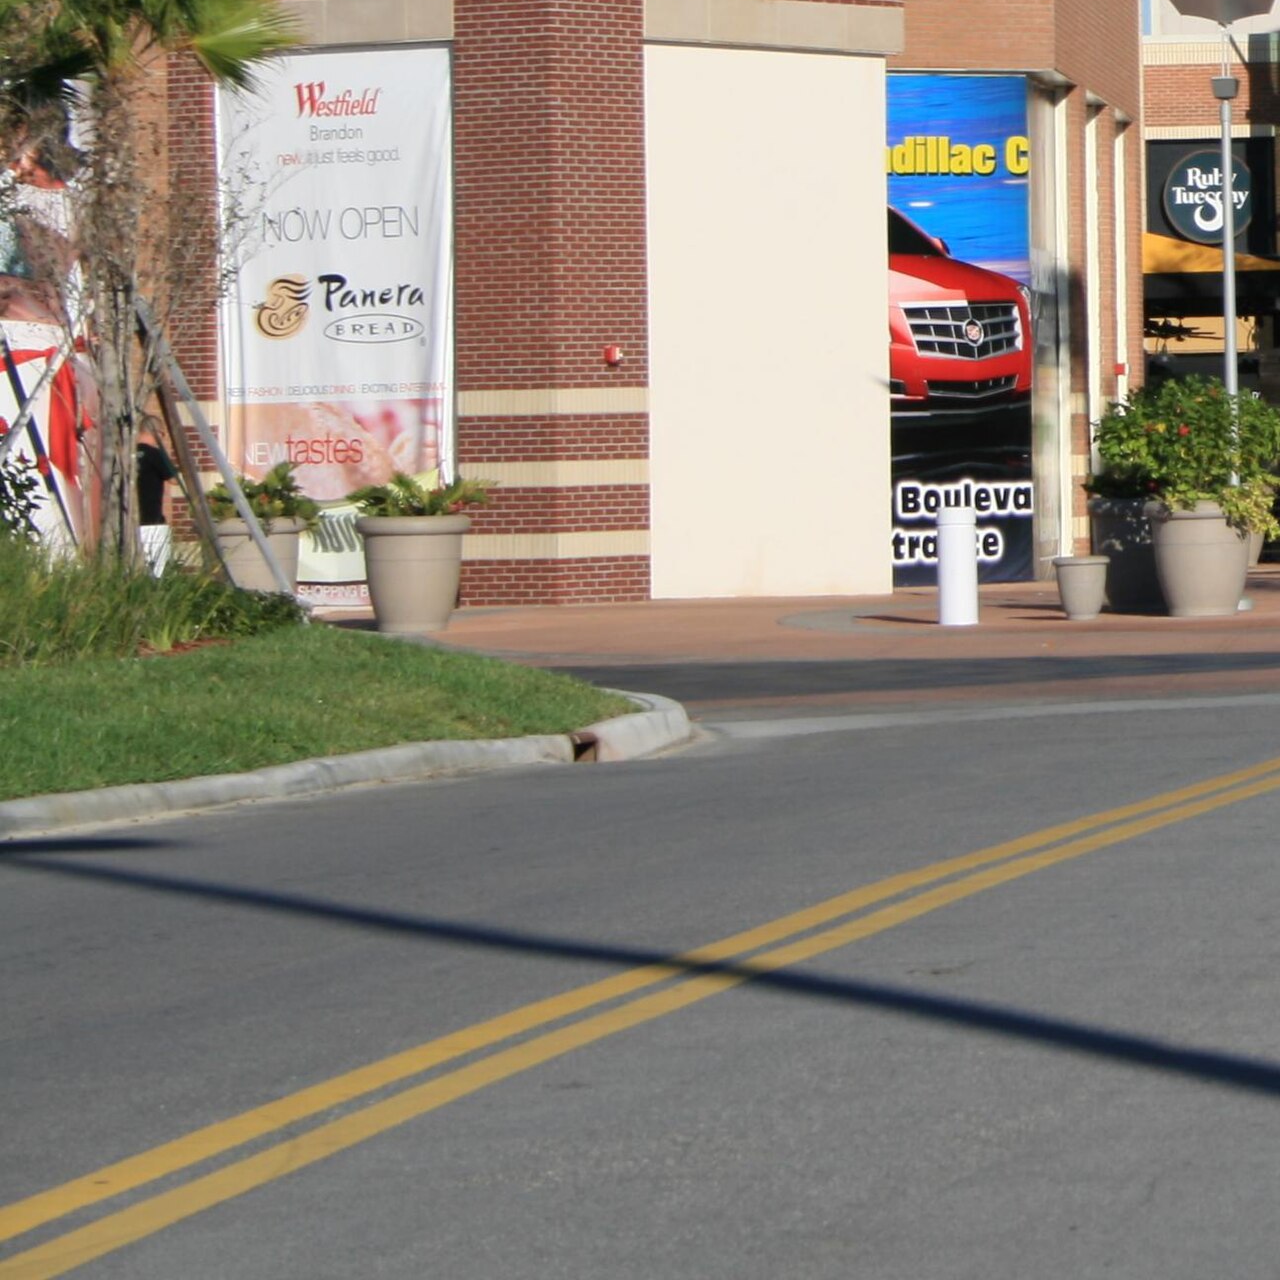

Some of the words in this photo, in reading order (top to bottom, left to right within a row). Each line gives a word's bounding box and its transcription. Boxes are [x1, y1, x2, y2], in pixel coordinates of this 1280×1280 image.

[294, 81, 381, 118] Westfield
[310, 125, 363, 141] Brandon
[262, 208, 332, 242] NOW
[340, 206, 420, 240] OPEN
[318, 274, 425, 311] Panera
[335, 324, 415, 336] BREAD
[286, 432, 364, 465] tastes
[892, 530, 1003, 561] trae
